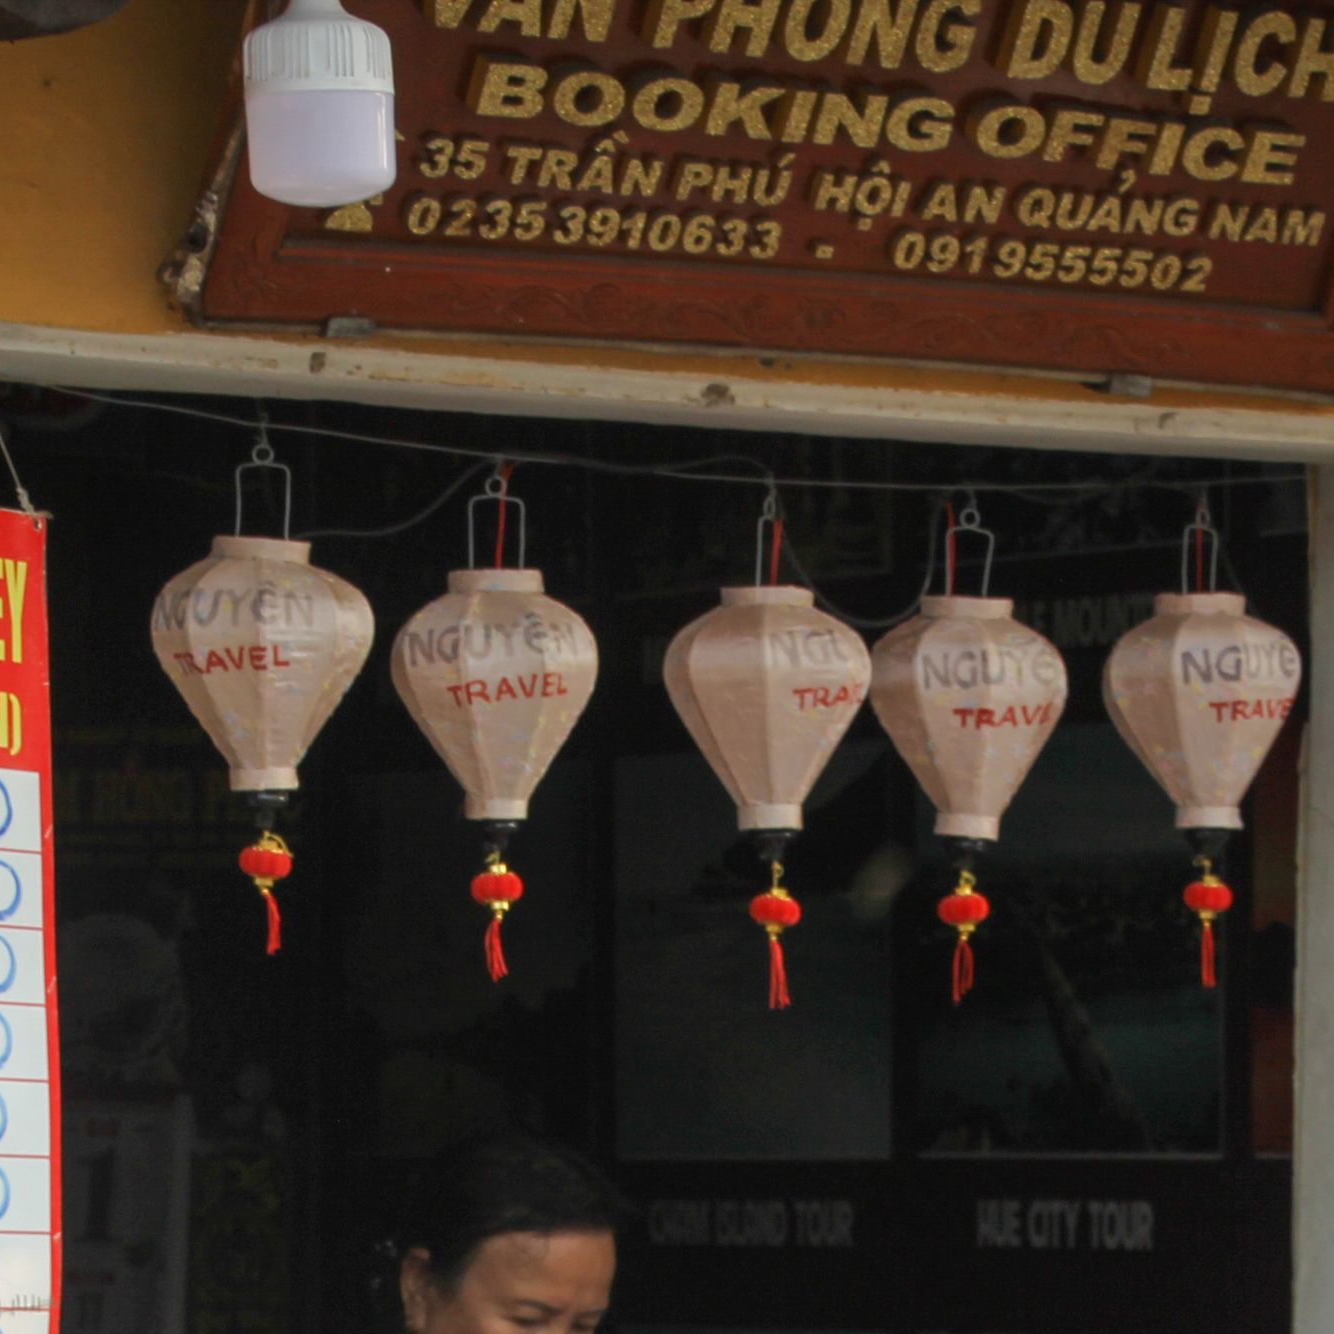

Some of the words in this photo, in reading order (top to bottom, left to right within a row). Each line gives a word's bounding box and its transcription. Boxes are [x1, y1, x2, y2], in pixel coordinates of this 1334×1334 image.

[1007, 0, 1141, 85] DU
[475, 61, 956, 153] BOOKING
[976, 105, 1307, 187] OFFICE
[418, 137, 490, 179] 35
[504, 130, 663, 197] TRẦN
[676, 152, 797, 206] PHÚ
[814, 159, 913, 231] HỘI
[921, 183, 1006, 225] AN
[1017, 169, 1201, 237] QUẢNG
[1207, 204, 1326, 248] NAM
[893, 232, 1214, 293] 0919555502
[446, 671, 568, 709] TRAVEL
